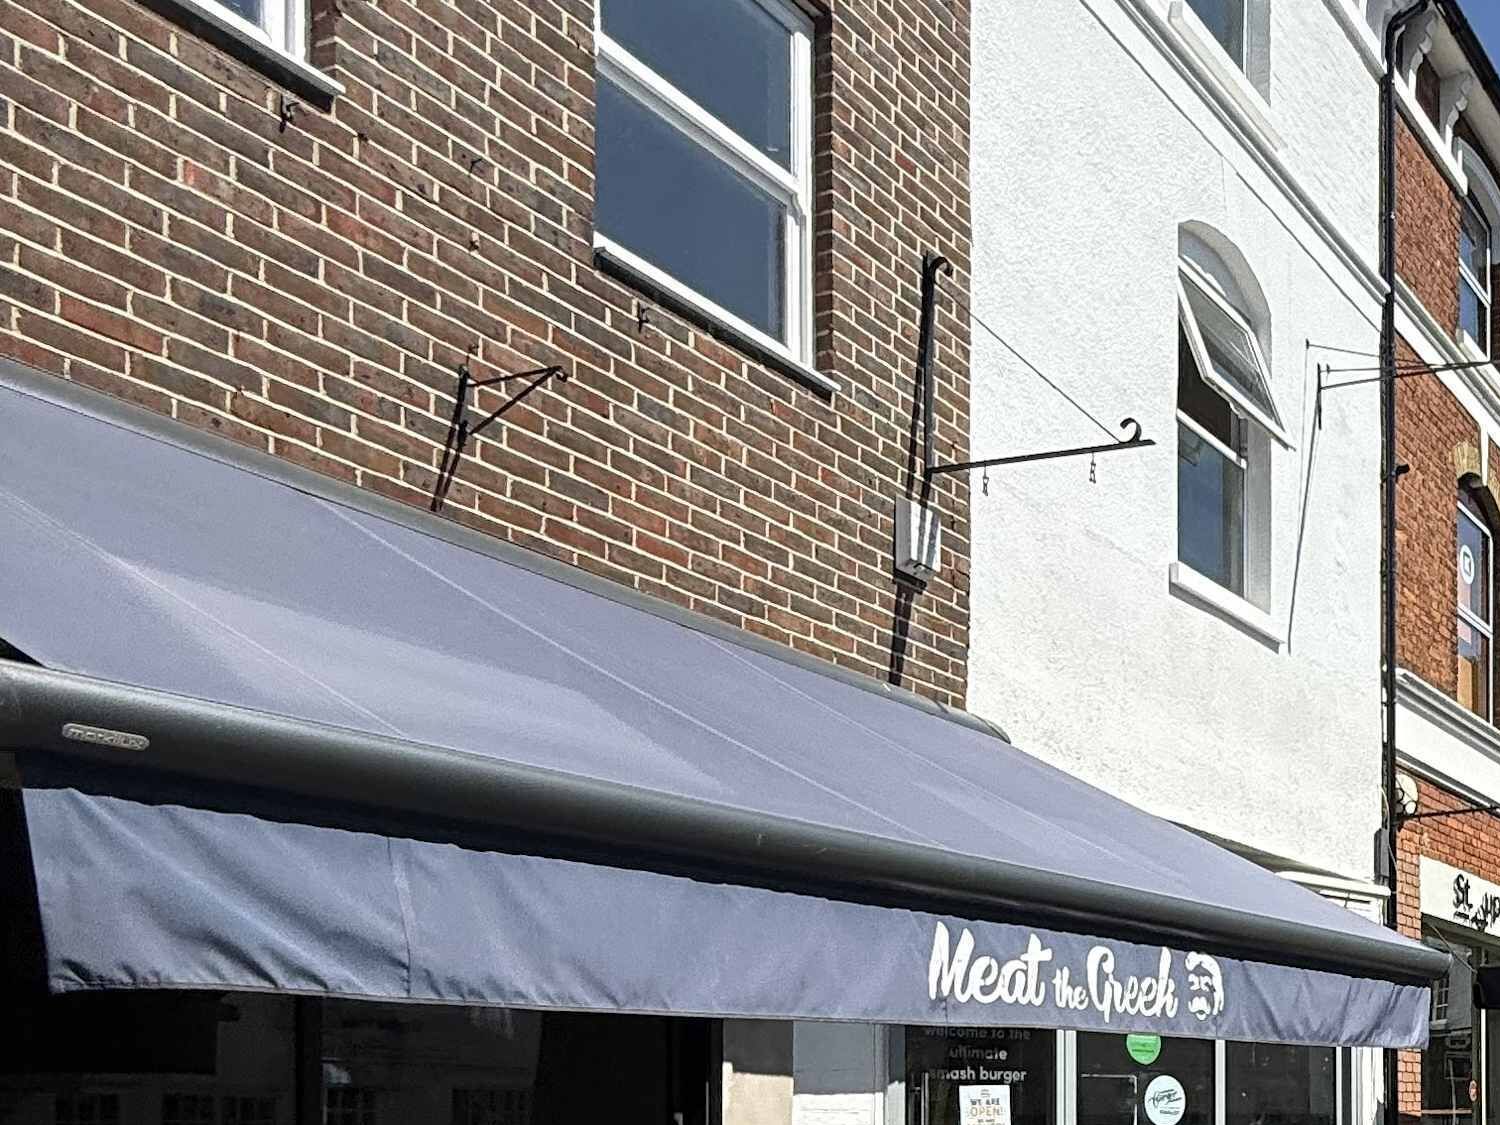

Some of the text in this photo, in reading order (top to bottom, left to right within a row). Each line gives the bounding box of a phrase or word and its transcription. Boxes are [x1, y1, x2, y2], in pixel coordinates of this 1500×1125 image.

[927, 920, 1179, 1024] Meat the Greek
[949, 1045, 1009, 1060] ultimate
[929, 1066, 1028, 1084] smash burger
